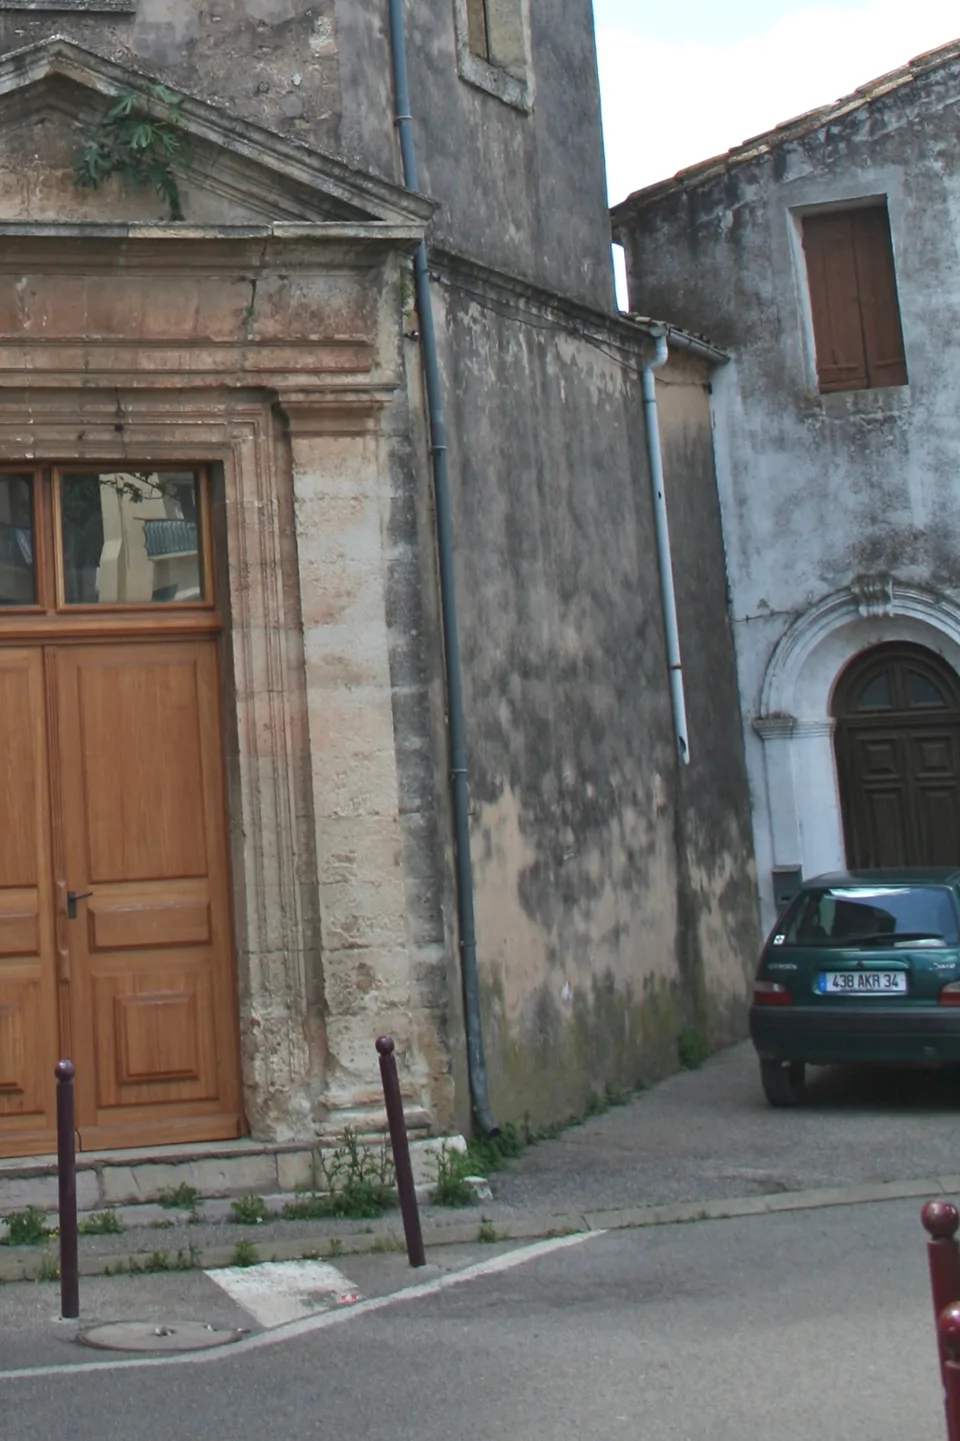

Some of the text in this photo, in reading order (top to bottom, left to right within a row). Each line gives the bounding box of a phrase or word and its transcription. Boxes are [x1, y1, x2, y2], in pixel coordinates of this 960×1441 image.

[832, 973, 899, 988] 438 AKR 34
